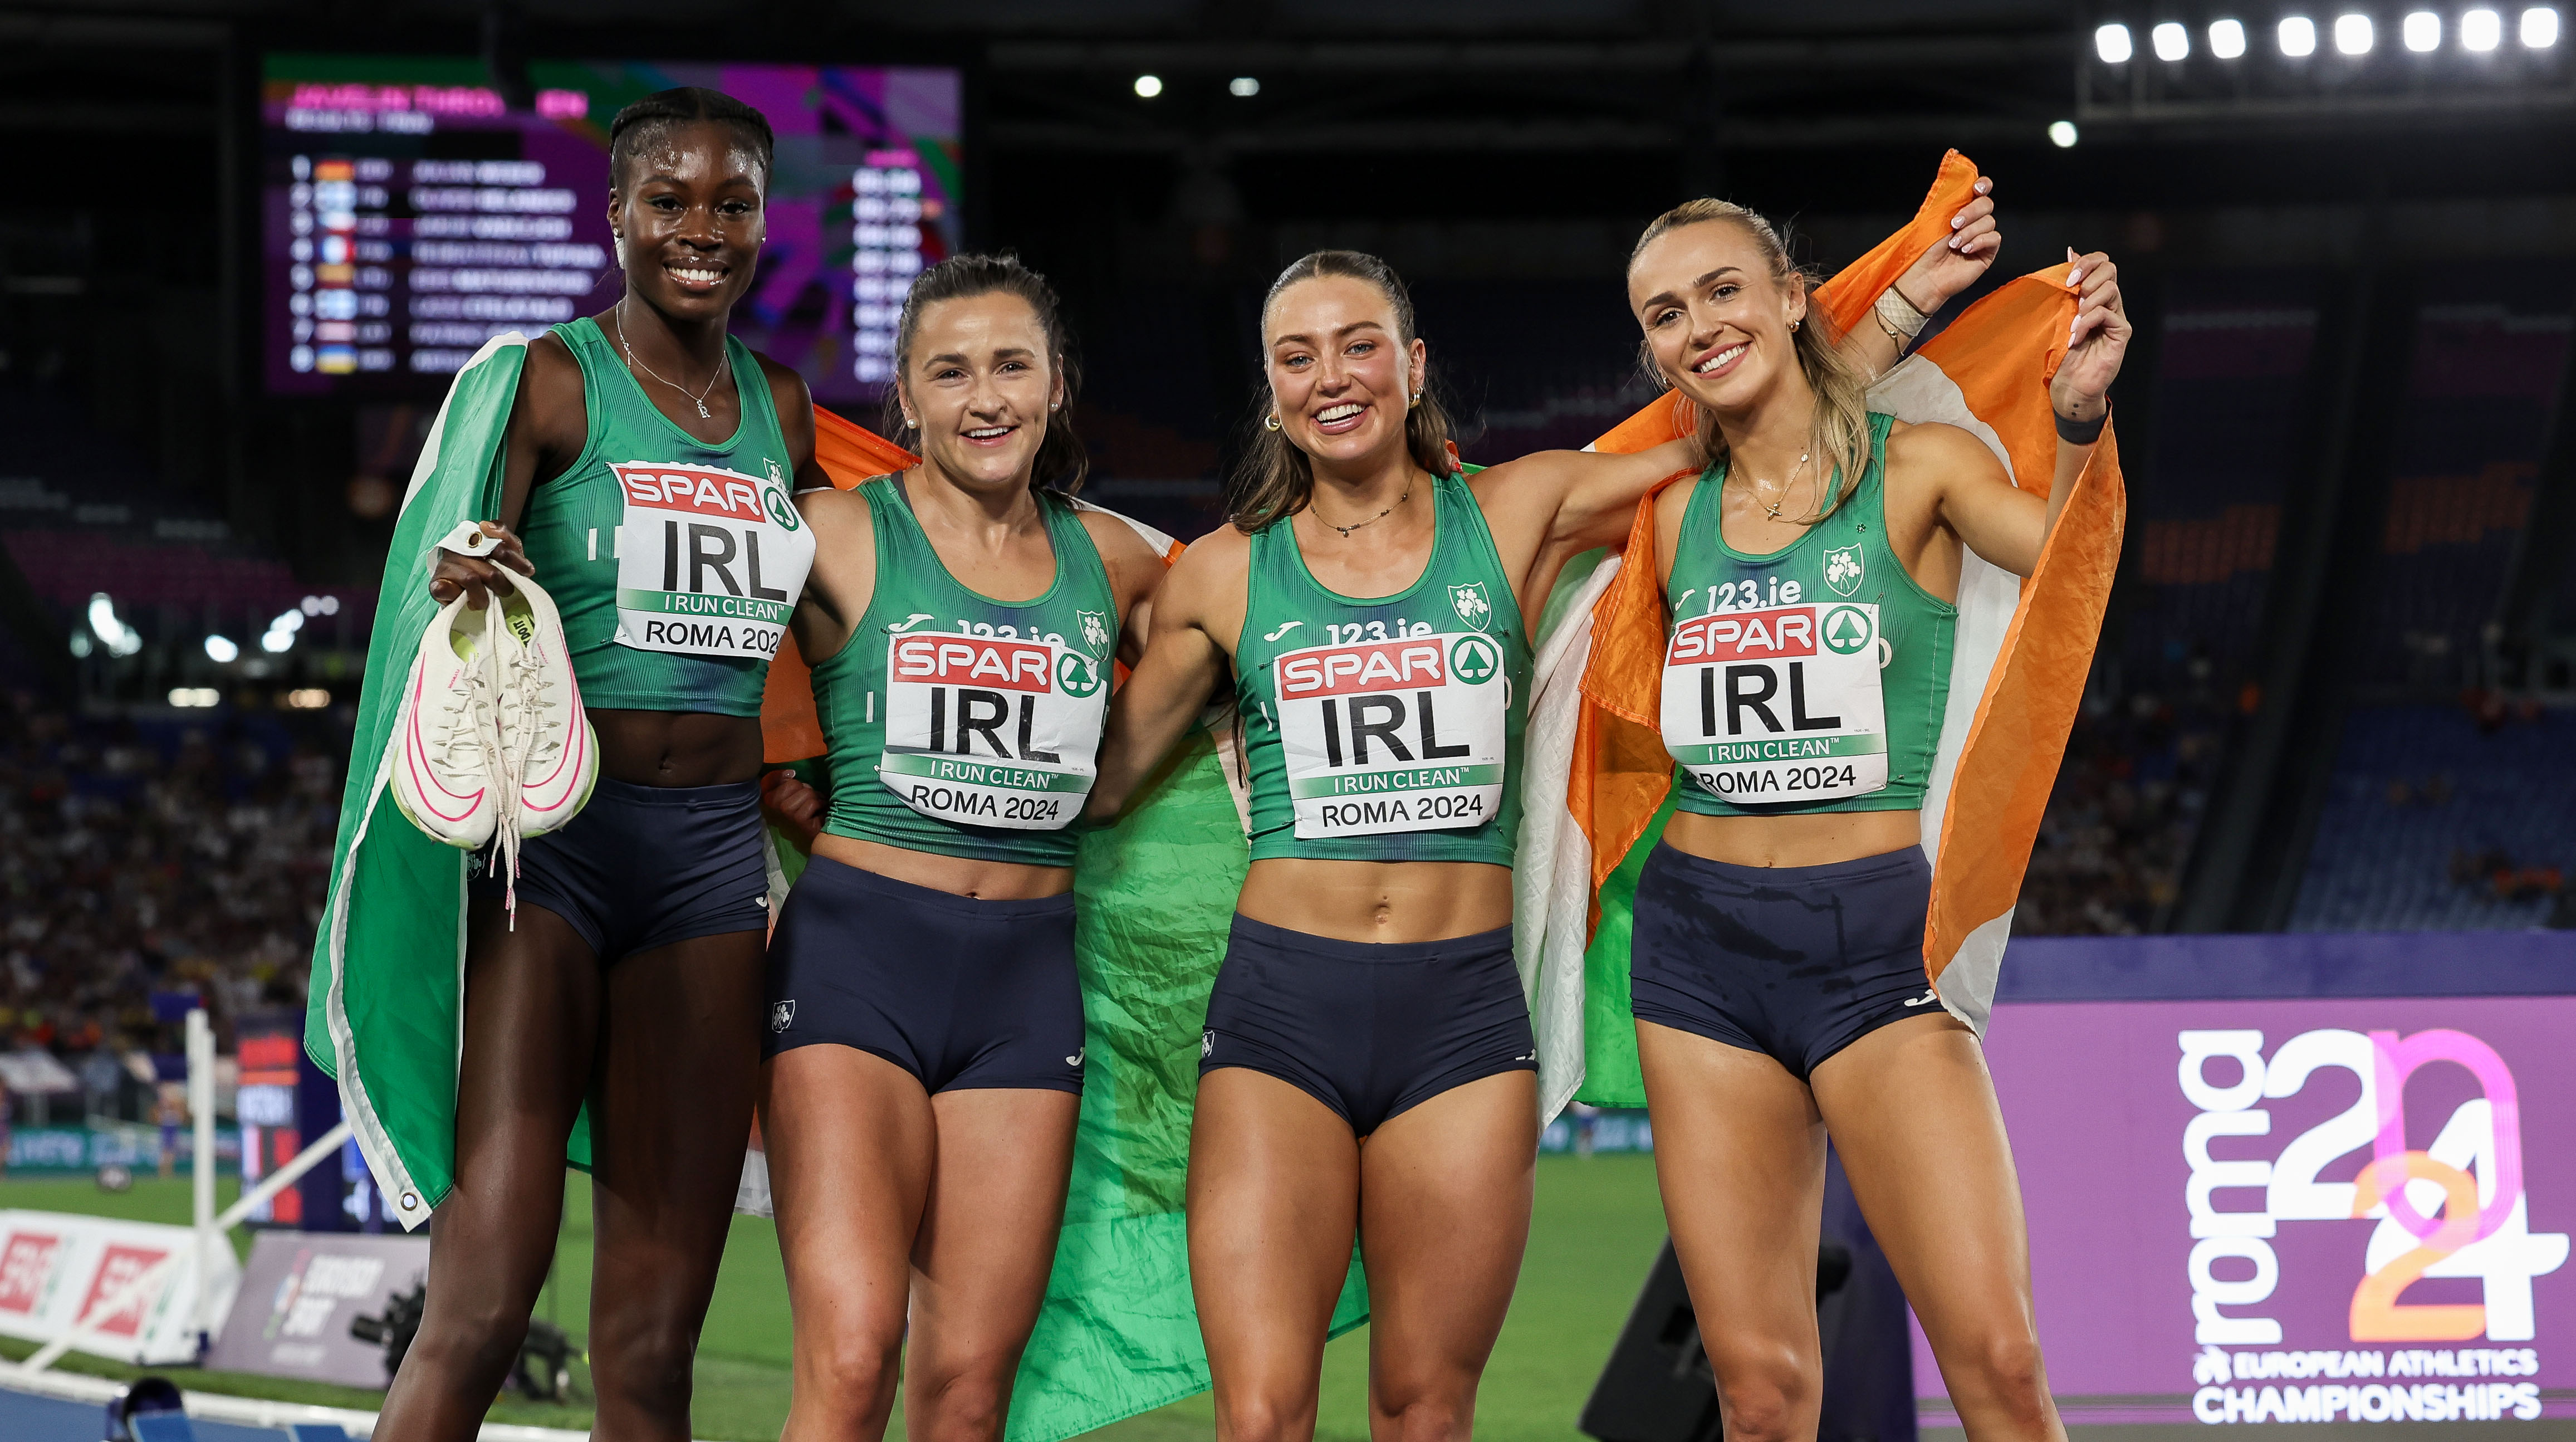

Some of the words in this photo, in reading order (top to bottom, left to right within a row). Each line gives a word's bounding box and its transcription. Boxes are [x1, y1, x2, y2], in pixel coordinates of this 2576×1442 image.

[625, 473, 761, 516] SPAR
[663, 520, 787, 603] IRL
[665, 594, 670, 610] I
[675, 595, 718, 613] RUN
[1707, 576, 1801, 613] 123.ie
[645, 620, 735, 649] ROMA
[742, 627, 783, 654] 202
[1673, 615, 1813, 658] SPAR
[898, 642, 1048, 686] SPAR
[1284, 647, 1442, 693] SPAR
[1700, 661, 1842, 737] IRL
[929, 687, 1061, 764] IRL
[1321, 691, 1471, 768] IRL
[931, 760, 936, 776] I
[941, 761, 986, 783] RUN
[1708, 746, 1713, 762] I
[1718, 743, 1760, 761] RUN
[1335, 778, 1339, 793] I
[1344, 774, 1389, 793] RUN
[1698, 769, 1780, 794] ROMA
[1786, 764, 1857, 791] 2024
[912, 784, 998, 818] ROMA
[1003, 796, 1059, 820] 2024
[1321, 799, 1411, 828] ROMA
[1417, 794, 1483, 820] 2024
[2178, 1029, 2283, 1344] roma
[2233, 1350, 2386, 1380] EUROPEAN
[2388, 1348, 2540, 1377] ATHLETICS
[2192, 1382, 2544, 1425] CHAMPIONSHIPS
